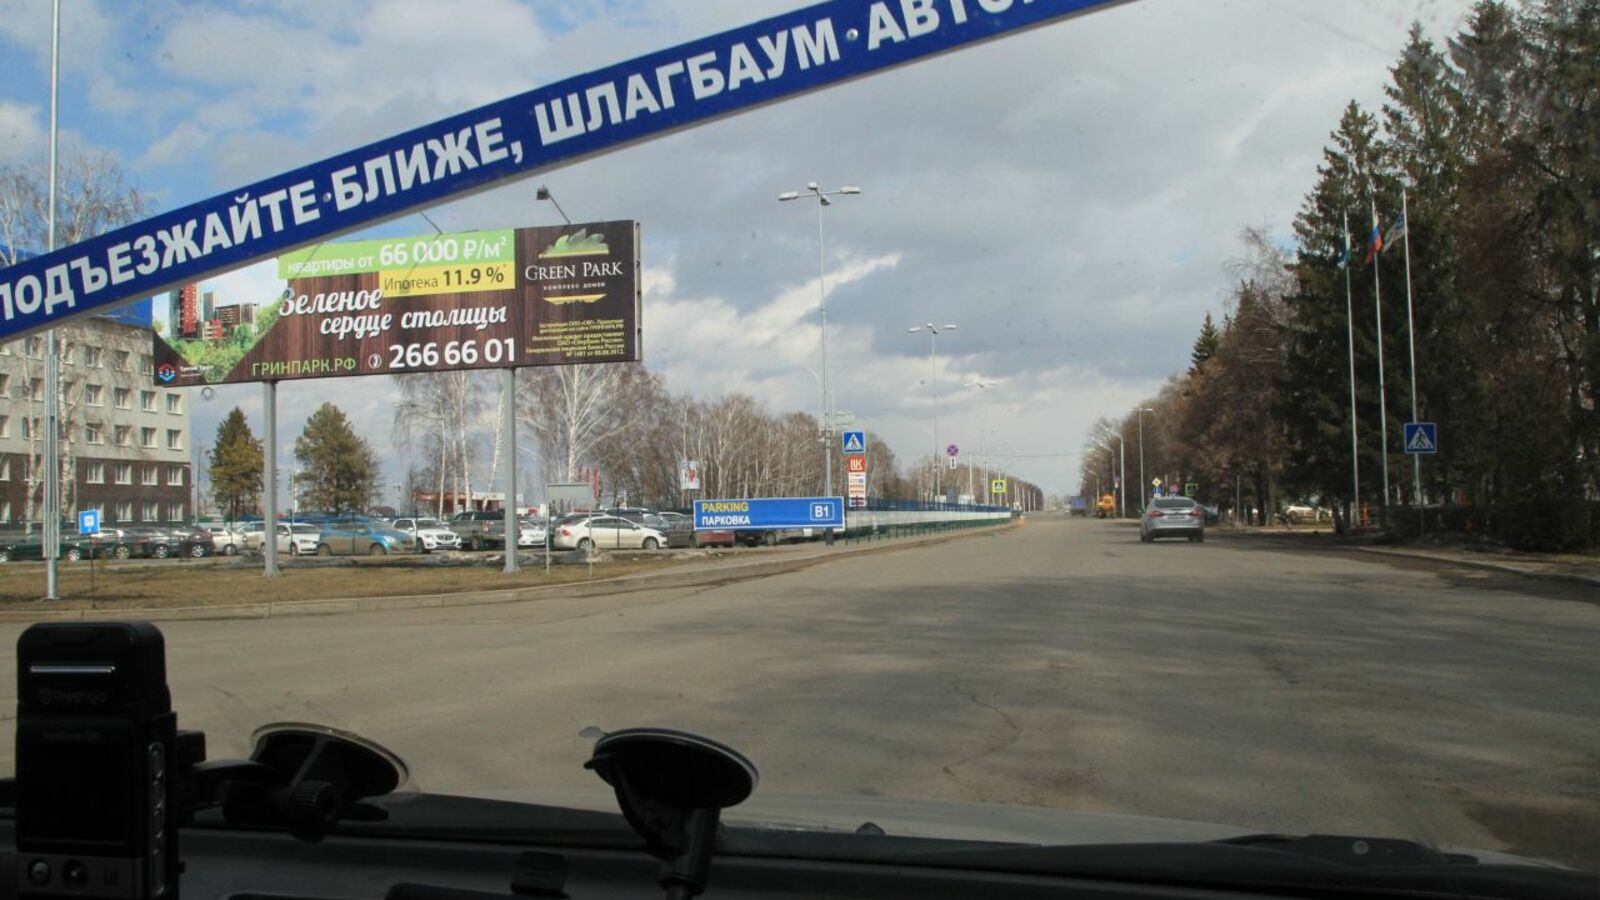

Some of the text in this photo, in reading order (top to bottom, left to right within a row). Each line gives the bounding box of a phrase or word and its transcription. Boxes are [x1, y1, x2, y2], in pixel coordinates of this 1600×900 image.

[331, 119, 524, 211] БЛИЖЕ,
[534, 18, 841, 147] ШЛАГБАУМ
[288, 256, 354, 275] квартиры
[359, 256, 374, 268] от
[379, 242, 408, 266] 66
[413, 239, 457, 264] 000
[384, 276, 438, 292] Ипотека
[443, 267, 481, 287] 11.9
[279, 287, 384, 317] Зеленое
[320, 305, 508, 341] сердце столицы
[252, 357, 357, 377] ГРИНПАРК.РФ
[389, 337, 516, 370] 266 66 01
[701, 501, 749, 513] PARKING
[701, 515, 751, 526] ПАРКОВКА
